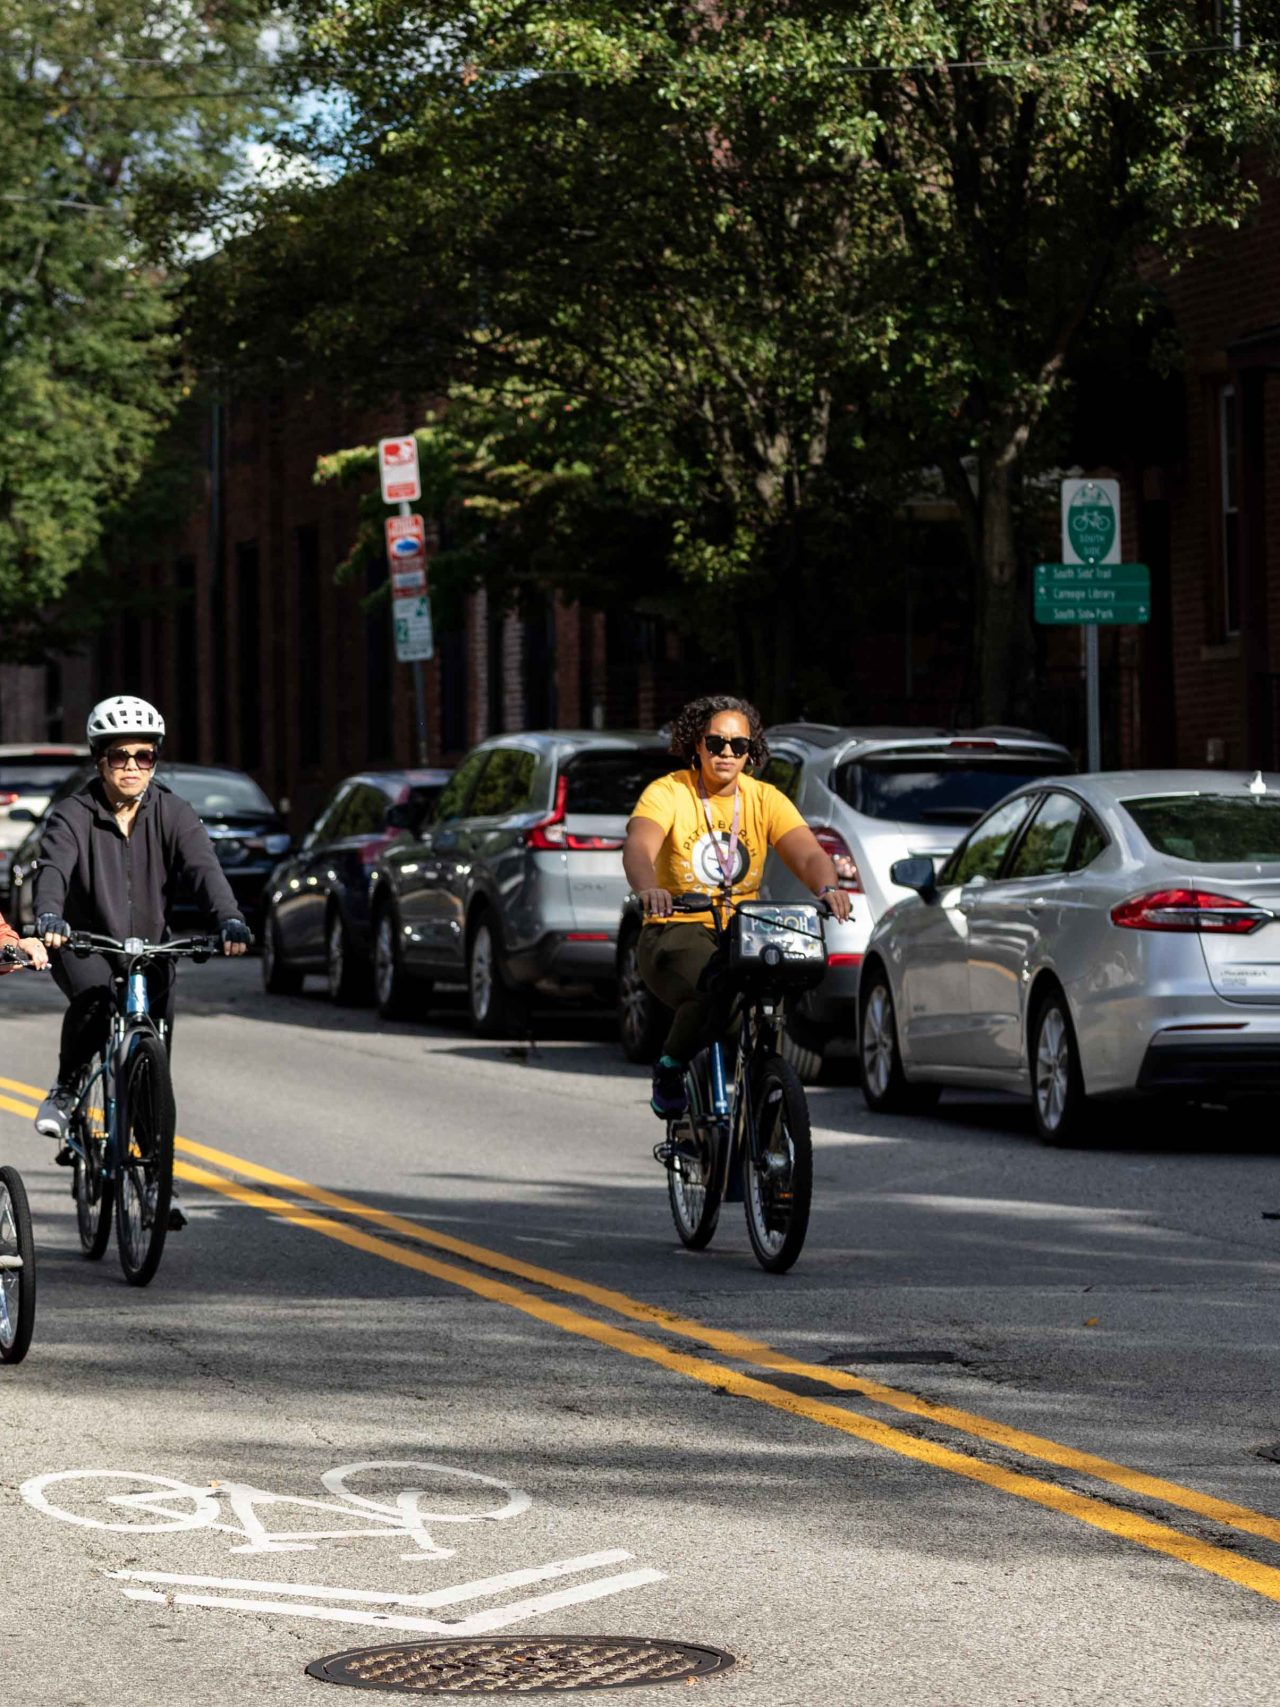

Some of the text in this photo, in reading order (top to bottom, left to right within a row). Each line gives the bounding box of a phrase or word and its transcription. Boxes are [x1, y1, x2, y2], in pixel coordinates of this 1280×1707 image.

[1079, 534, 1105, 543] SOUTH
[1053, 568, 1112, 579] South Side Trail
[1088, 588, 1116, 601] Library
[1053, 608, 1074, 619] South
[1096, 608, 1113, 619] Park
[683, 820, 757, 858] PITTBRGH
[751, 915, 809, 931] POGOH
